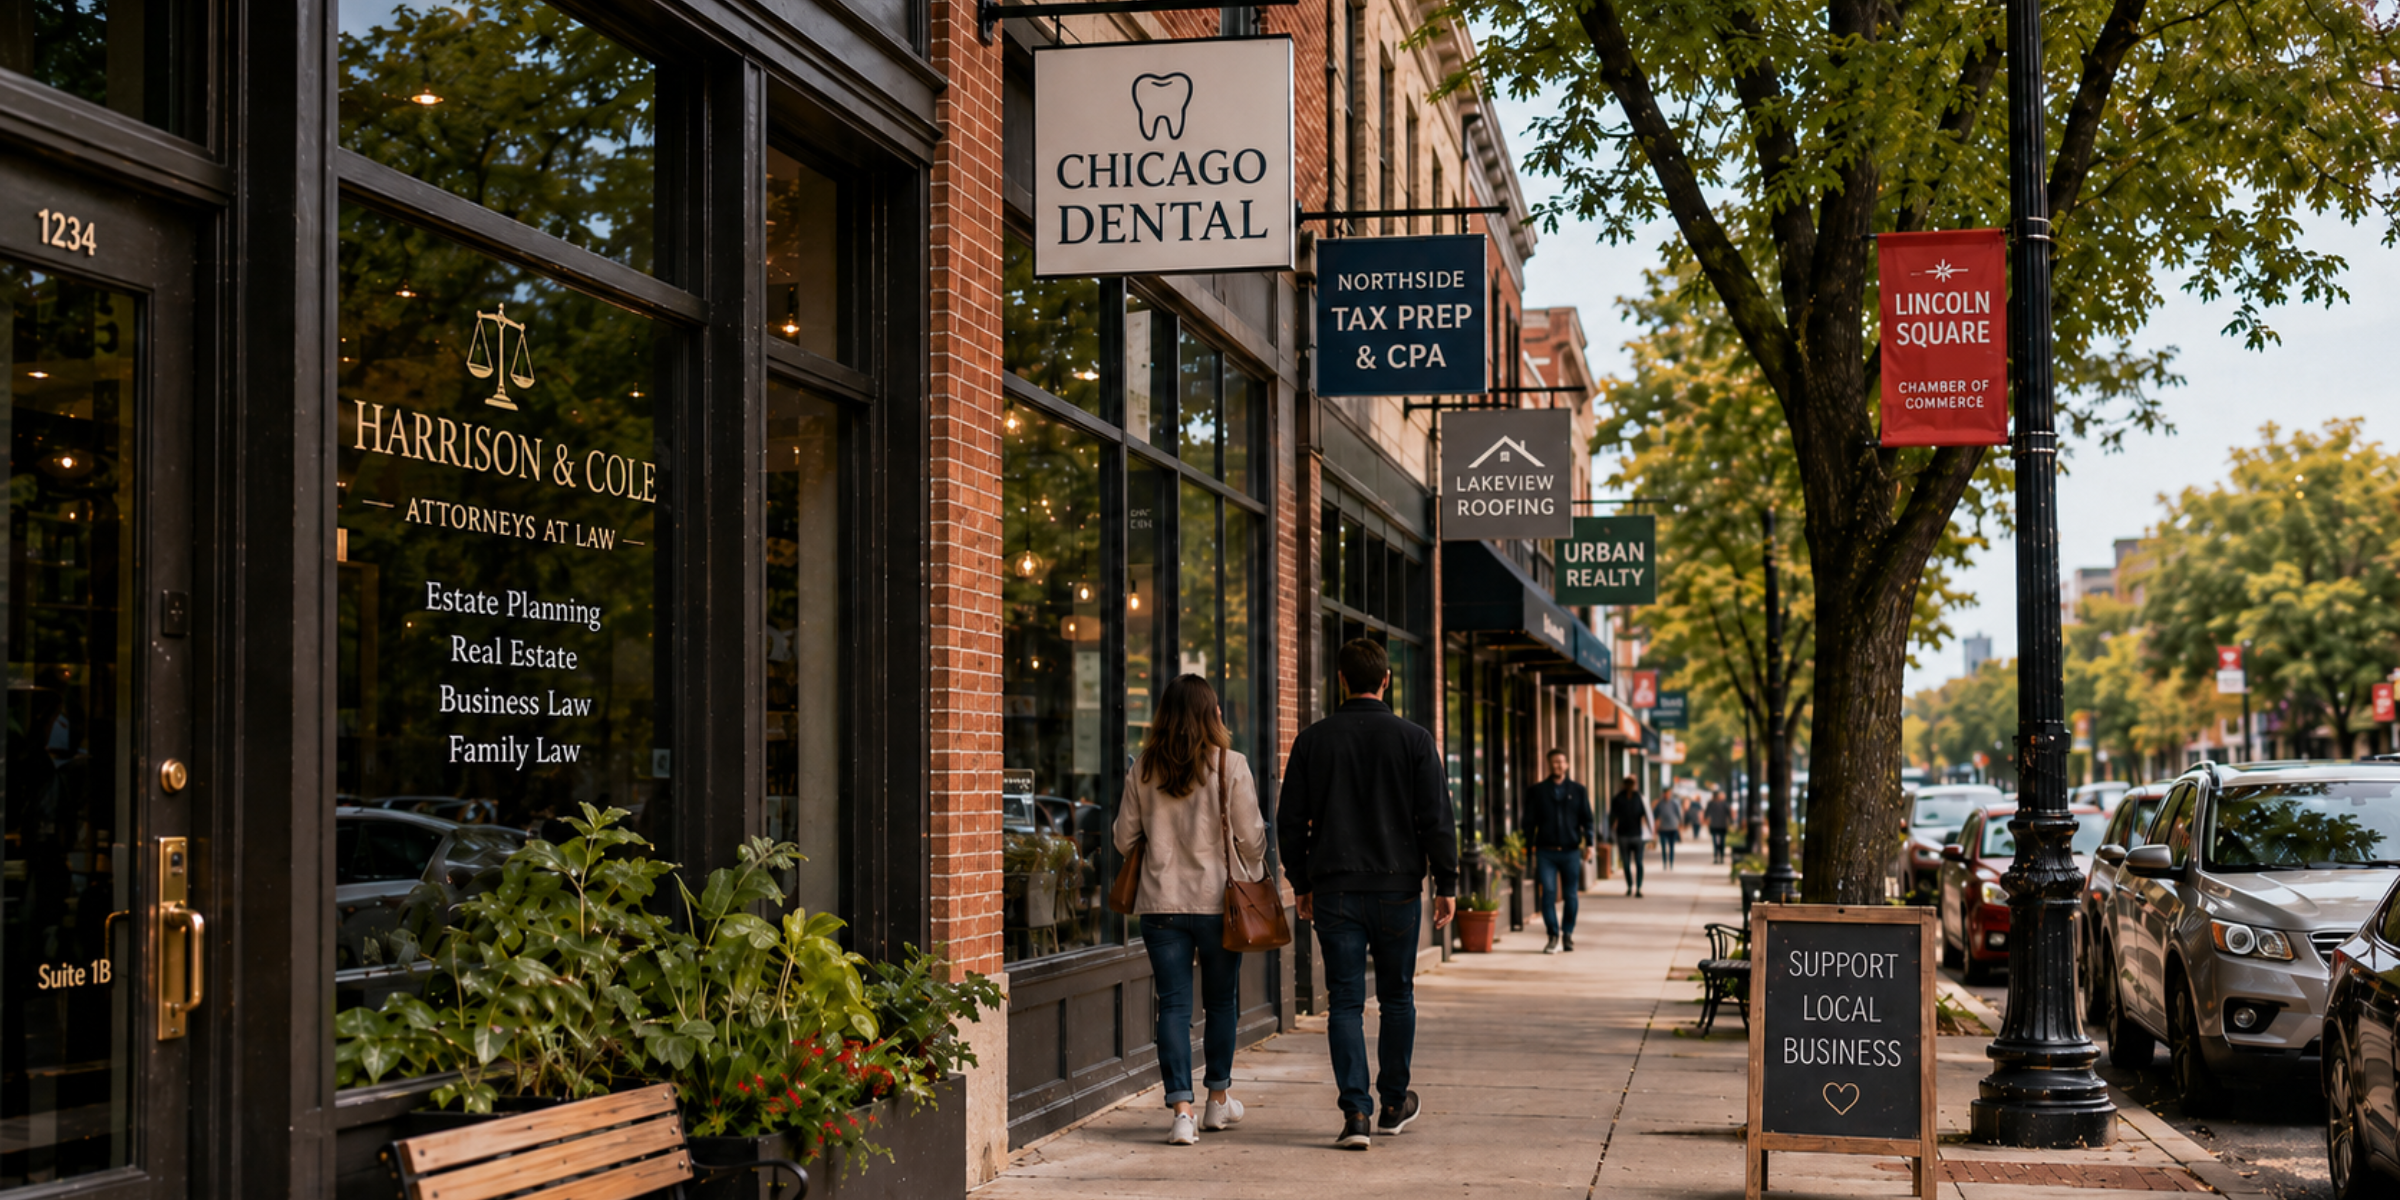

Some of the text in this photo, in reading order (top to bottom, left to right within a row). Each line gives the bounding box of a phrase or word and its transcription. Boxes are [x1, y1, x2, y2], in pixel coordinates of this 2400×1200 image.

[1056, 148, 1267, 190] CHICAGO
[38, 208, 97, 256] 1234
[1057, 199, 1269, 245] DENTAL
[1338, 270, 1465, 291] NORTHSIDE
[1331, 303, 1473, 332] TAX PREP
[1895, 290, 1990, 316] LINCOLN
[1896, 320, 1991, 347] SQUARE
[1356, 343, 1447, 370] & CPA
[1898, 379, 1989, 394] CHAMBER OF
[1905, 395, 1985, 410] COMMERCE
[354, 400, 657, 504] HARRISON & COLE
[1456, 474, 1554, 492] LAKEVIEW
[1457, 497, 1555, 517] ROOFING
[404, 497, 616, 550] ATTORNEYS AT LAW
[1564, 541, 1645, 563] URBAN
[1566, 567, 1645, 588] REALTY
[426, 581, 601, 632] Estate Planning
[451, 634, 578, 670] Real Estate
[439, 684, 592, 718] Business Law
[449, 734, 581, 772] Family Law
[37, 958, 112, 990] Suite 1B
[1788, 950, 1899, 979] SUPPORT
[1802, 994, 1882, 1023] LOCAL
[1783, 1037, 1902, 1067] BUSINESS
